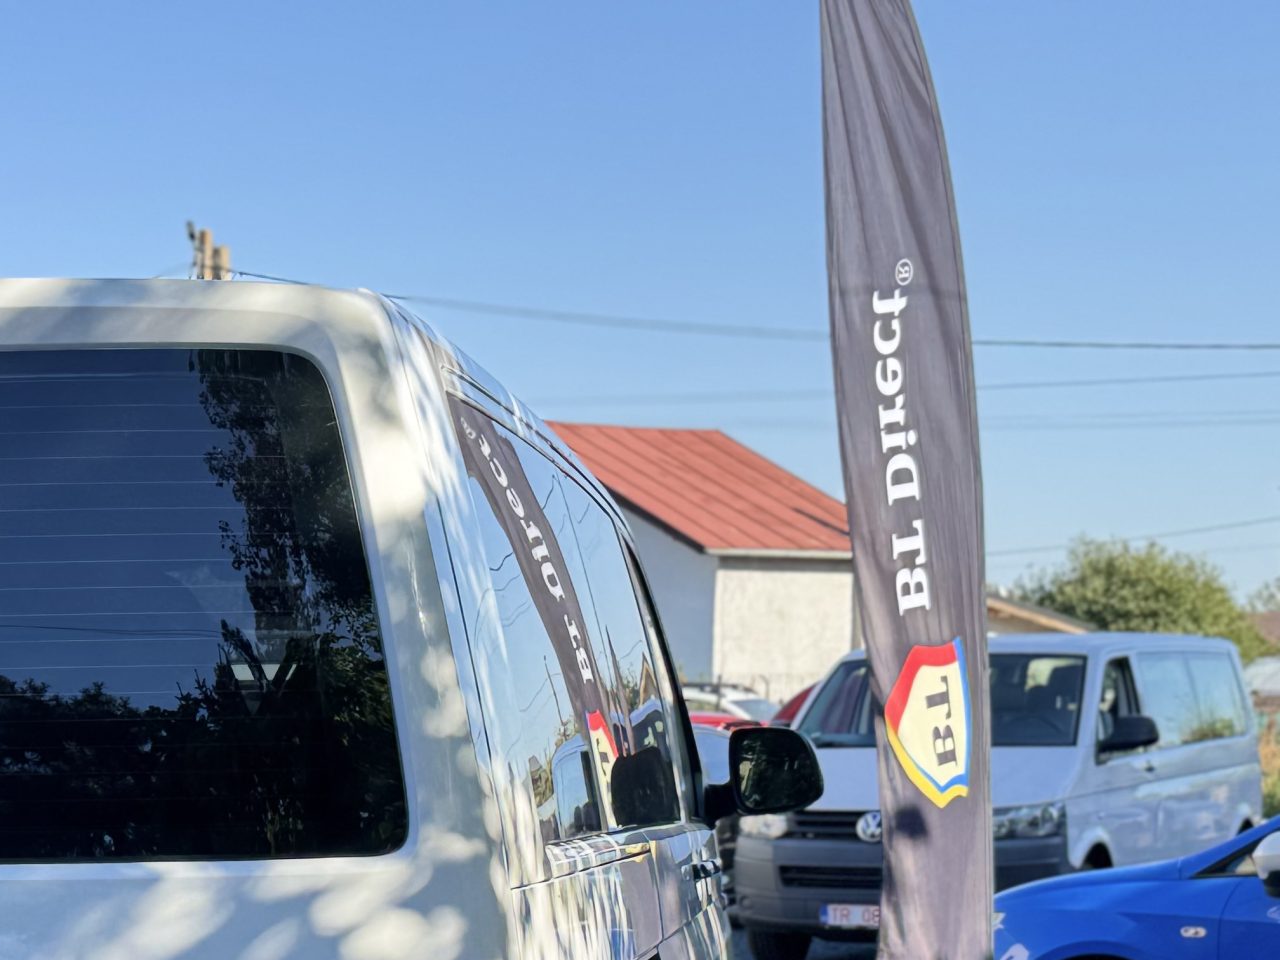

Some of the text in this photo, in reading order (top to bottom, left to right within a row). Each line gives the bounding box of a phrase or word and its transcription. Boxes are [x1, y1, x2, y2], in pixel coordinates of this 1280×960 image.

[892, 518, 931, 617] BT
[925, 675, 958, 767] BT
[831, 906, 850, 922] TR
